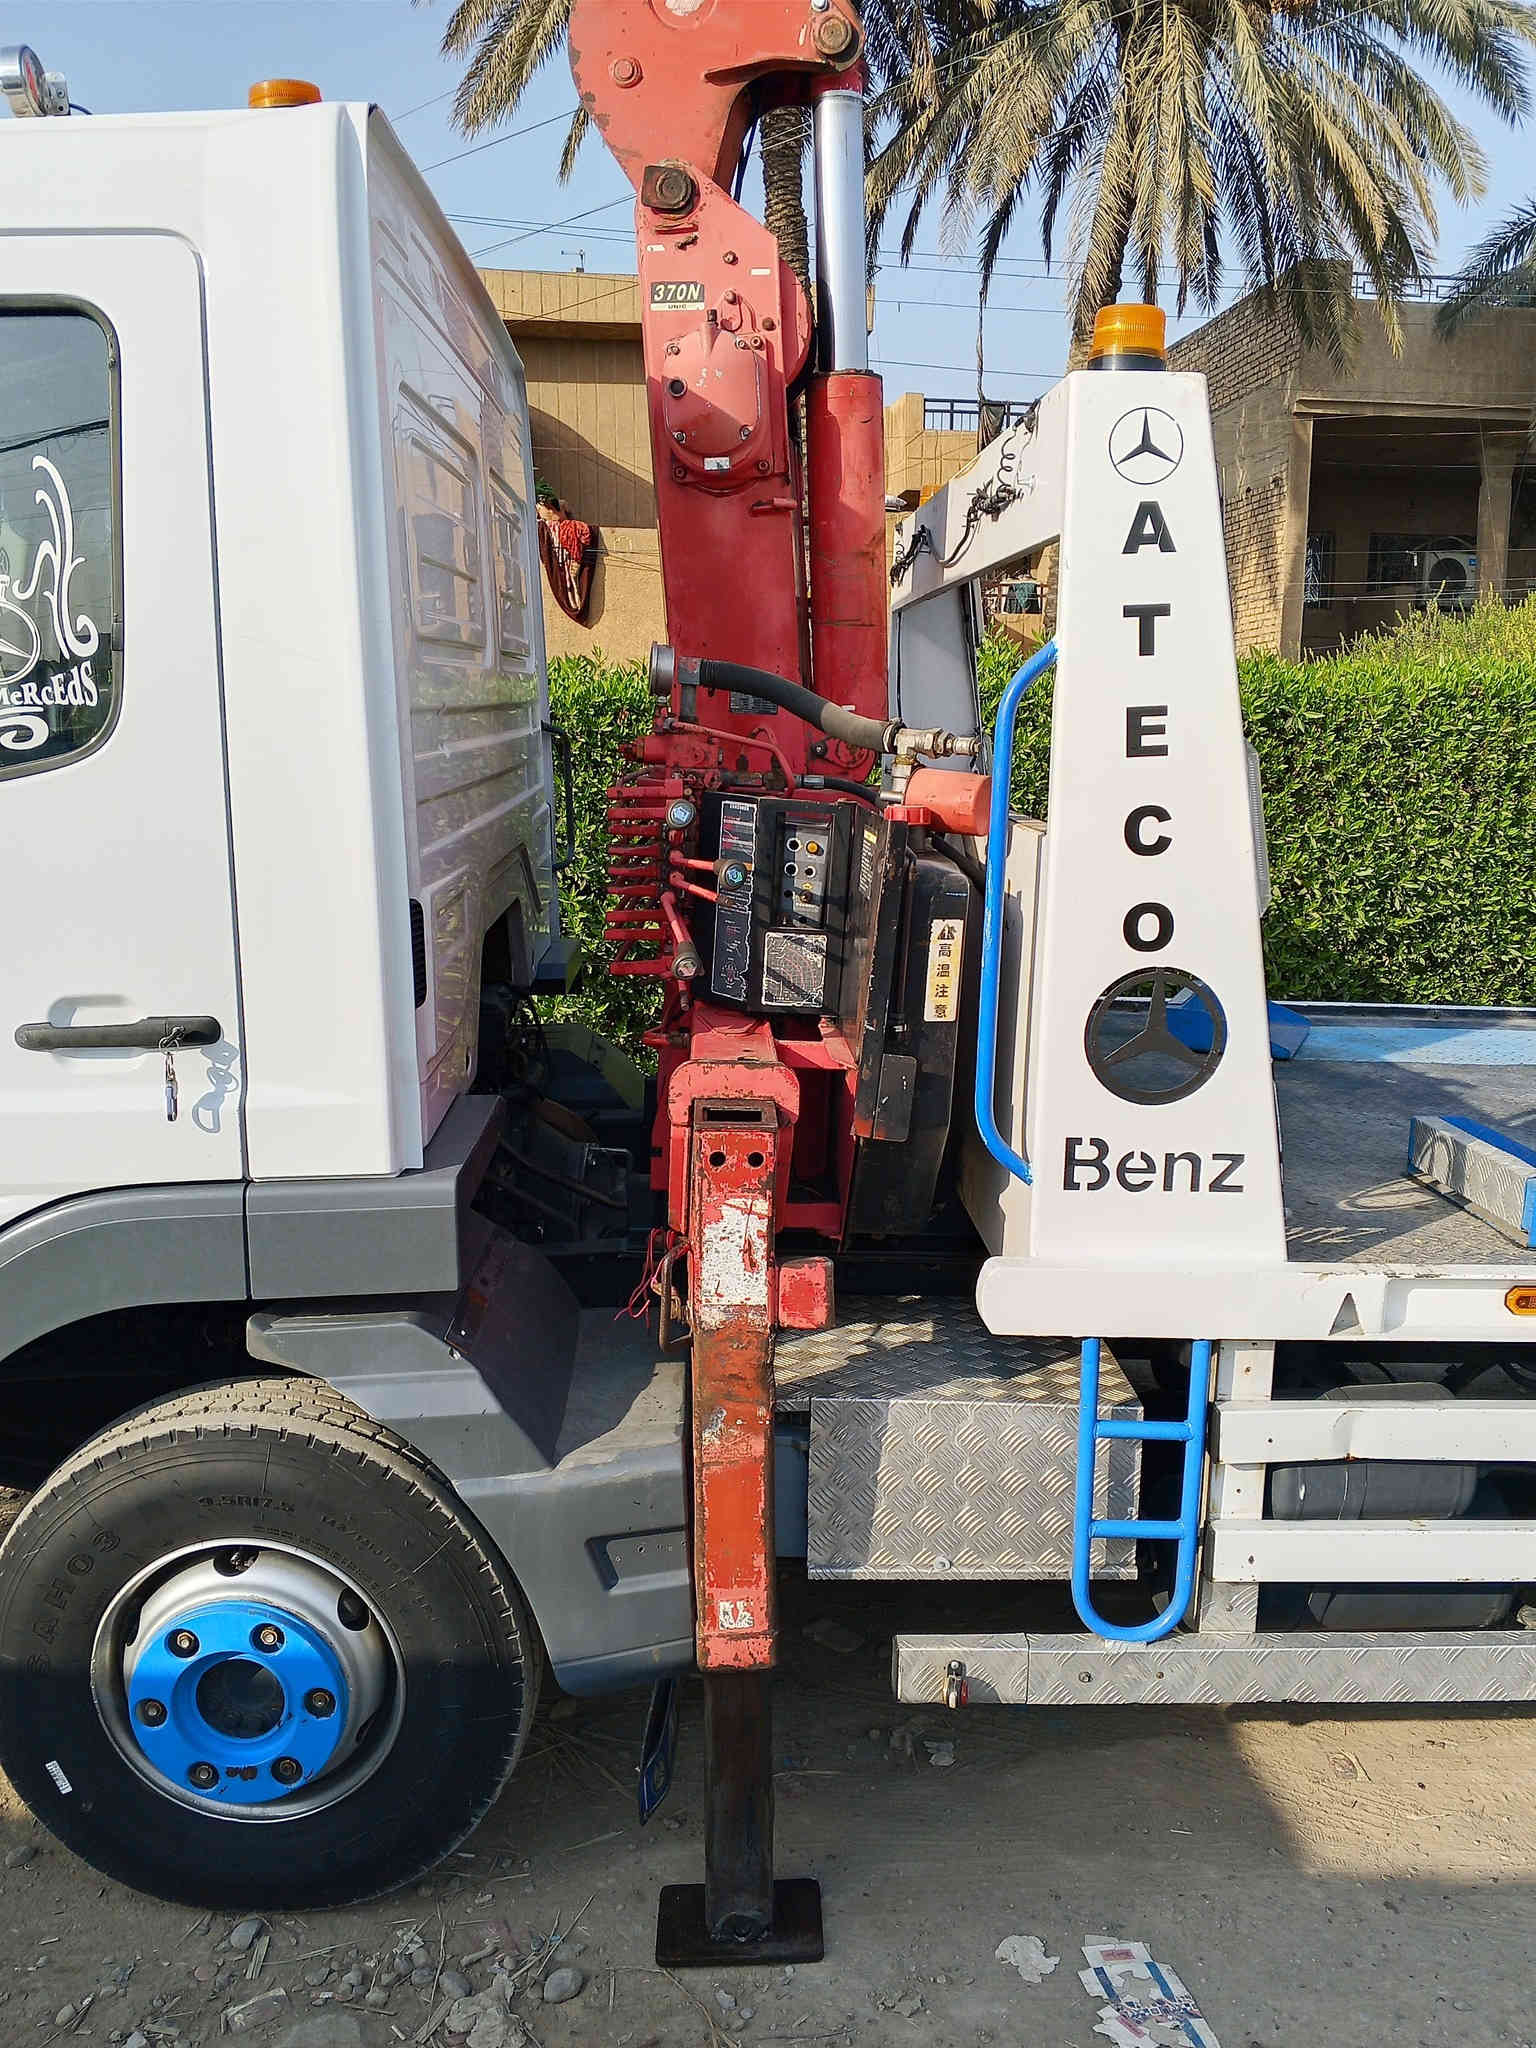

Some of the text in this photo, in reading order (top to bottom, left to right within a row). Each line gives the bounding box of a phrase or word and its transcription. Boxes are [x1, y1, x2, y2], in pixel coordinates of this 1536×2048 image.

[654, 284, 700, 301] 370N
[1121, 501, 1177, 952] ATECO
[1063, 1137, 1246, 1193] Benz
